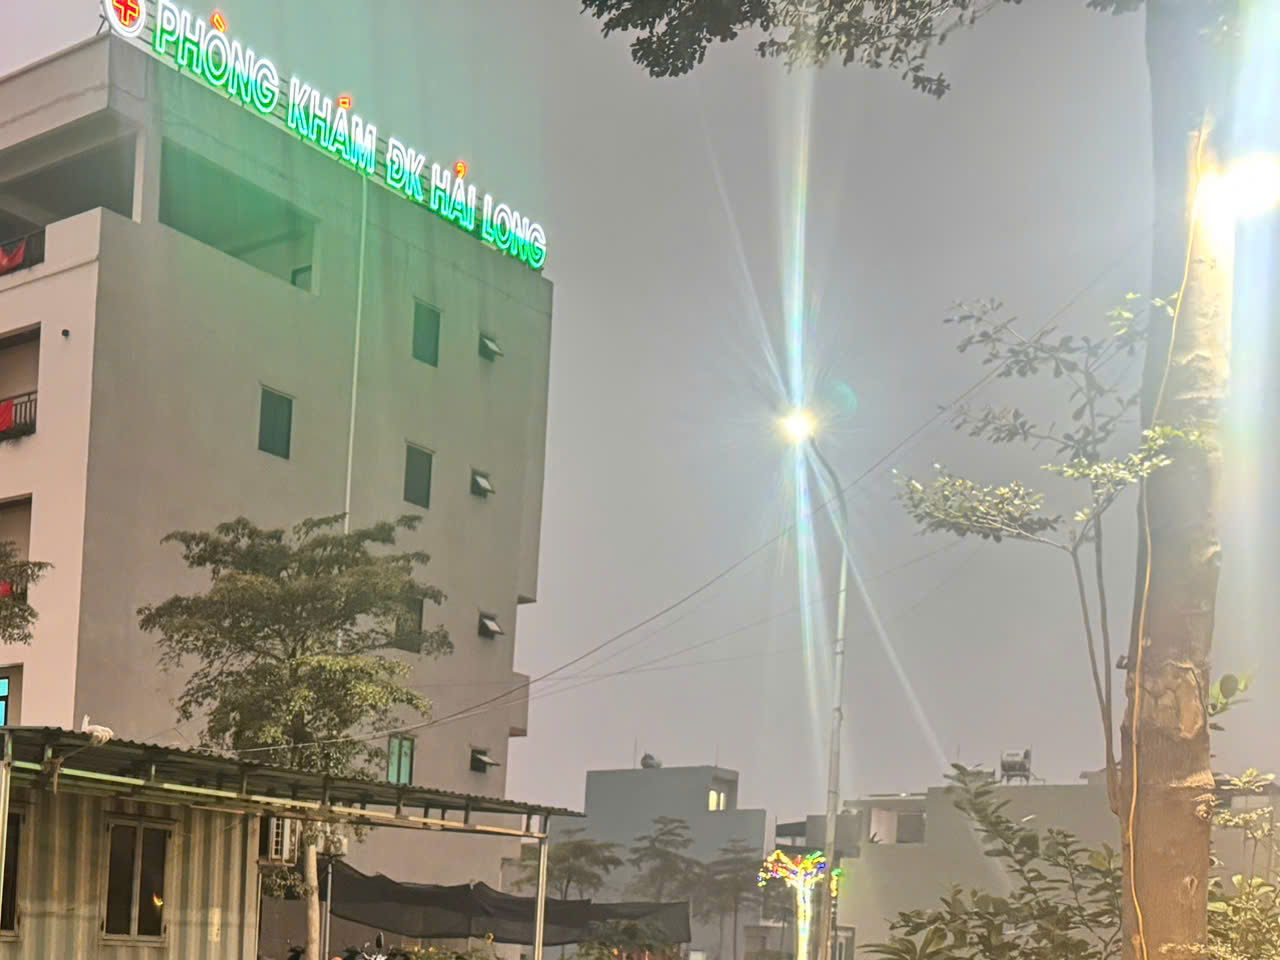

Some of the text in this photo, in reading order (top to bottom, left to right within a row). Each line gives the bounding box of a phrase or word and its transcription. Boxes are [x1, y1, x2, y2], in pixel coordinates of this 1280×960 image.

[155, 1, 547, 268] PHÒNG KHÁM ĐK HẢI LONG
